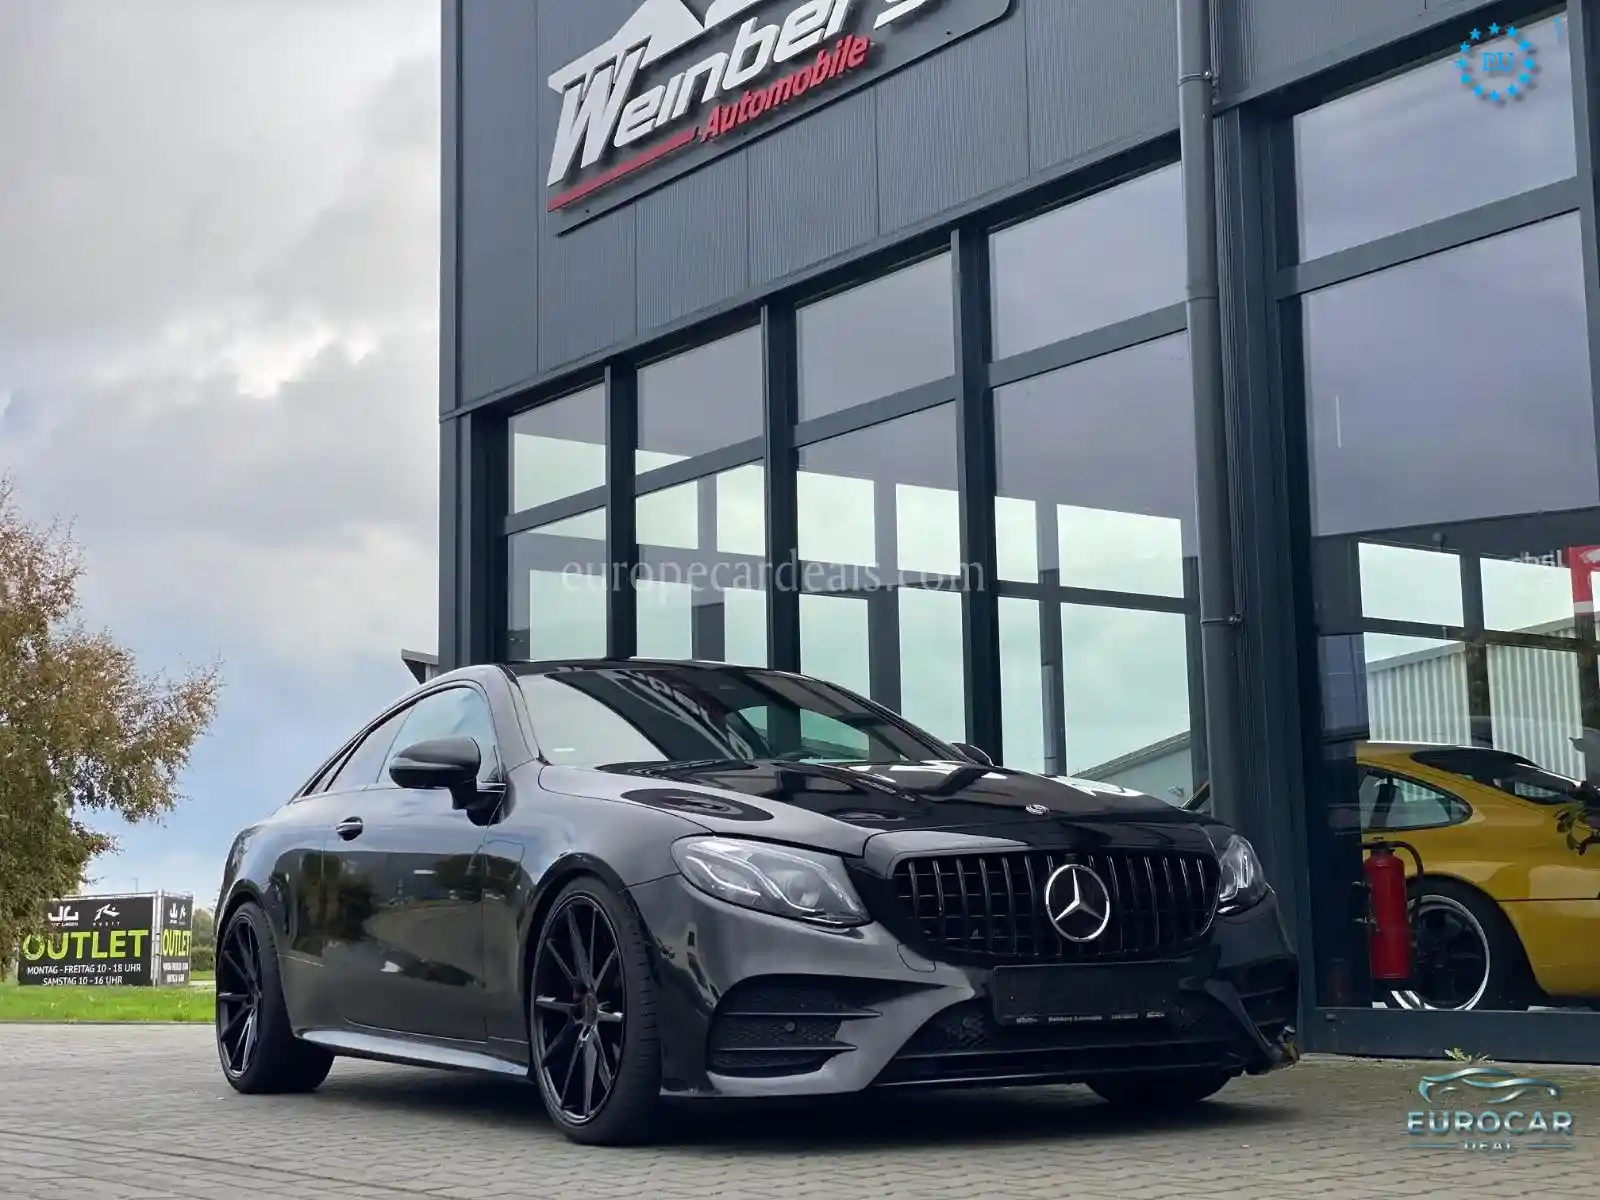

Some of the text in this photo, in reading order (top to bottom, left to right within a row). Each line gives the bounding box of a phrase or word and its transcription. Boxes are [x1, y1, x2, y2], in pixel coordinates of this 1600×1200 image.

[547, 0, 930, 187] Weinber
[700, 35, 871, 143] Automobile
[22, 929, 149, 961] OUTLET
[162, 929, 191, 957] OUTLET
[27, 965, 58, 975] MONTAG
[64, 964, 95, 974] FREITAG
[97, 964, 107, 973] 10
[113, 963, 123, 973] 18
[124, 963, 141, 973] UHR
[43, 977, 77, 986] SAMSTAG
[79, 976, 88, 985] 10
[94, 976, 104, 985] 16
[105, 975, 123, 985] UHR
